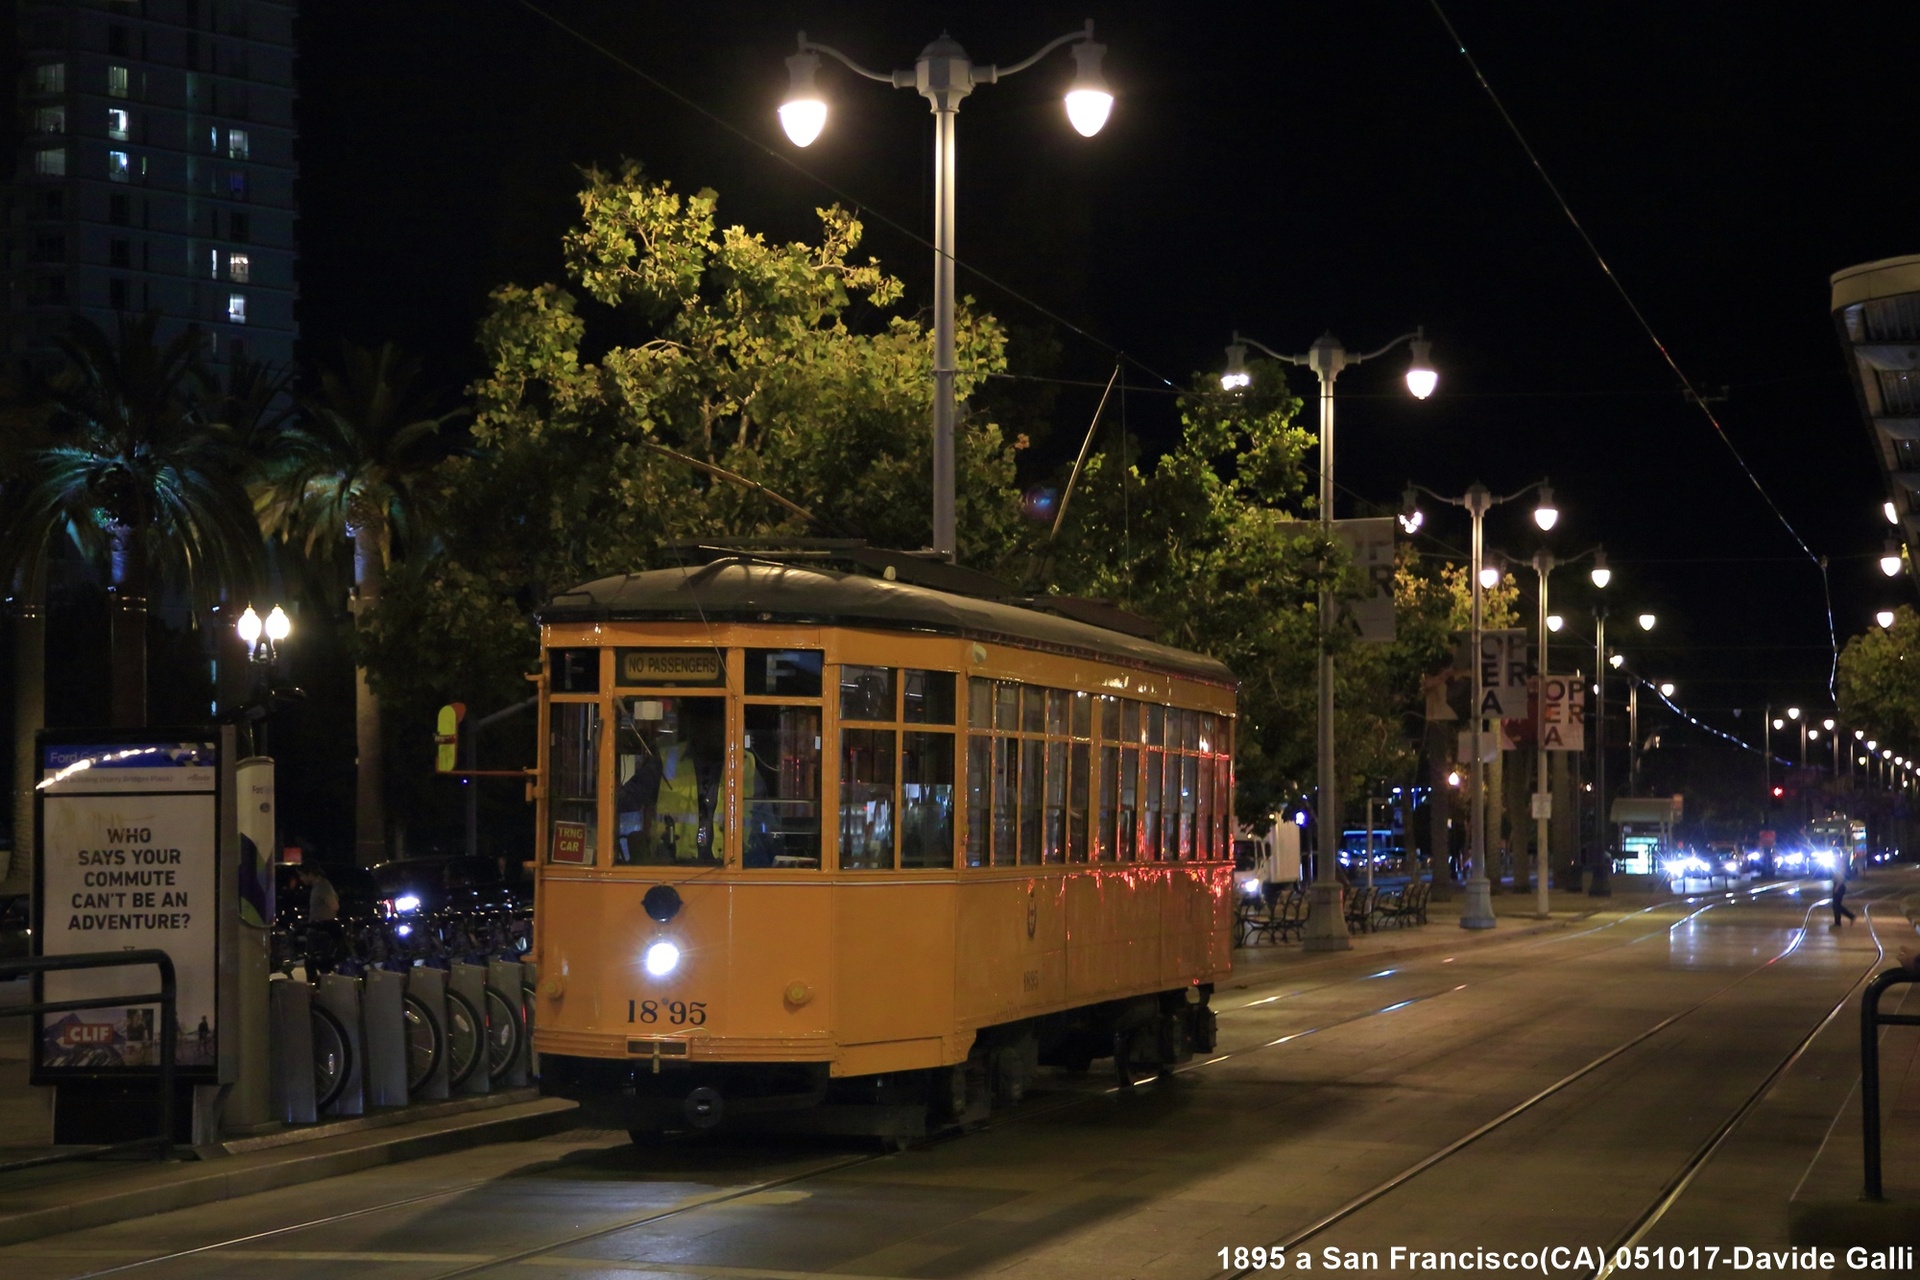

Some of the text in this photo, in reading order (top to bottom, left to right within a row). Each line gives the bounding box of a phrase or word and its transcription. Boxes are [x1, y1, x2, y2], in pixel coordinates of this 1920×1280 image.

[628, 656, 716, 674] NO PASSENGERS
[765, 653, 797, 692] F
[106, 828, 152, 844] WHO
[558, 827, 584, 840] TRNG
[560, 840, 579, 852] CAR
[78, 849, 181, 866] SAYS YOUR
[84, 870, 176, 887] COMMUTE
[71, 892, 188, 909] CAN'T BE AN
[68, 913, 191, 931] ADVENTURE?
[627, 999, 707, 1026] 1895
[69, 1026, 110, 1042] CLIF
